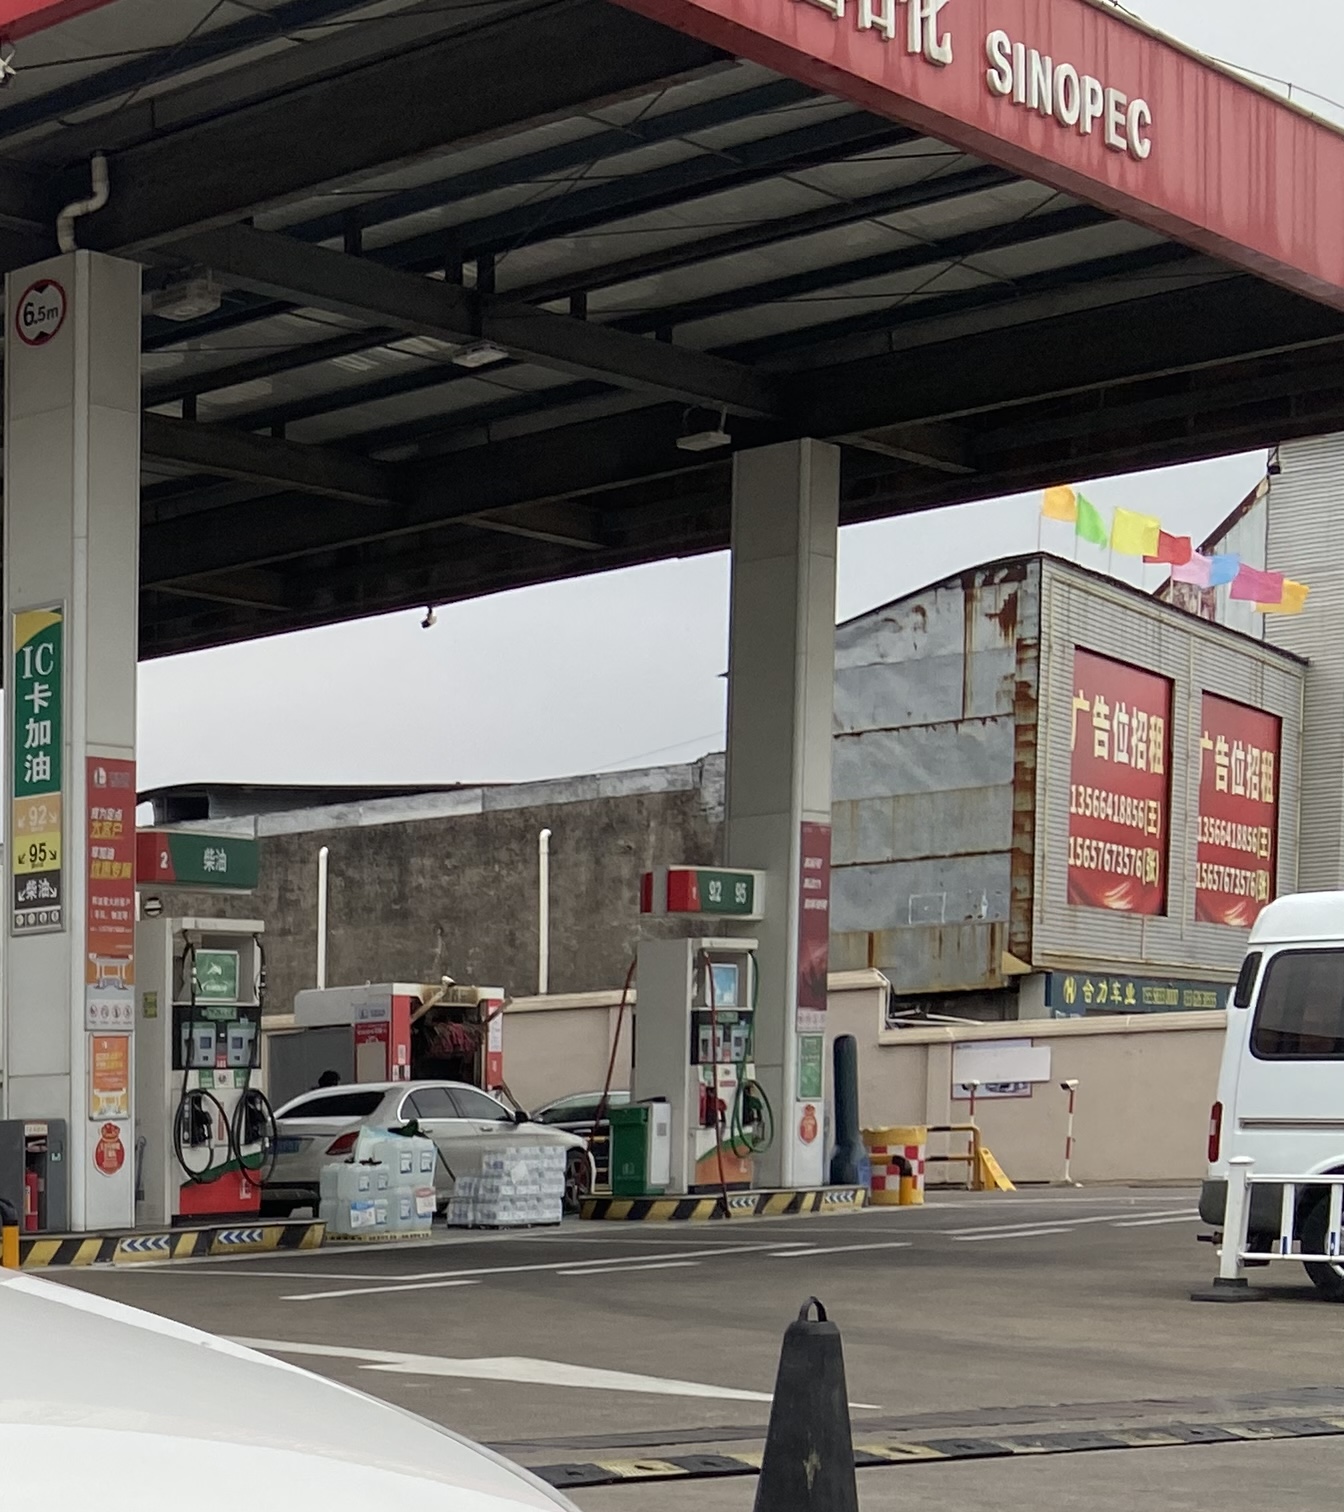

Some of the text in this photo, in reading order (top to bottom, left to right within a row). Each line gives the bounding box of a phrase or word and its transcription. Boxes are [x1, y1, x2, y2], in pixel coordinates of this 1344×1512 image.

[986, 29, 1152, 161] SINOPEC
[23, 301, 59, 327] 6.5m
[1071, 689, 1165, 775] 广告位招租
[1199, 730, 1274, 804] 广告位招租
[28, 805, 48, 827] 92
[28, 842, 47, 863] 95
[160, 847, 227, 873] 2 柴油
[26, 878, 50, 900] 柴油
[708, 880, 722, 903] 92
[735, 882, 747, 905] 95
